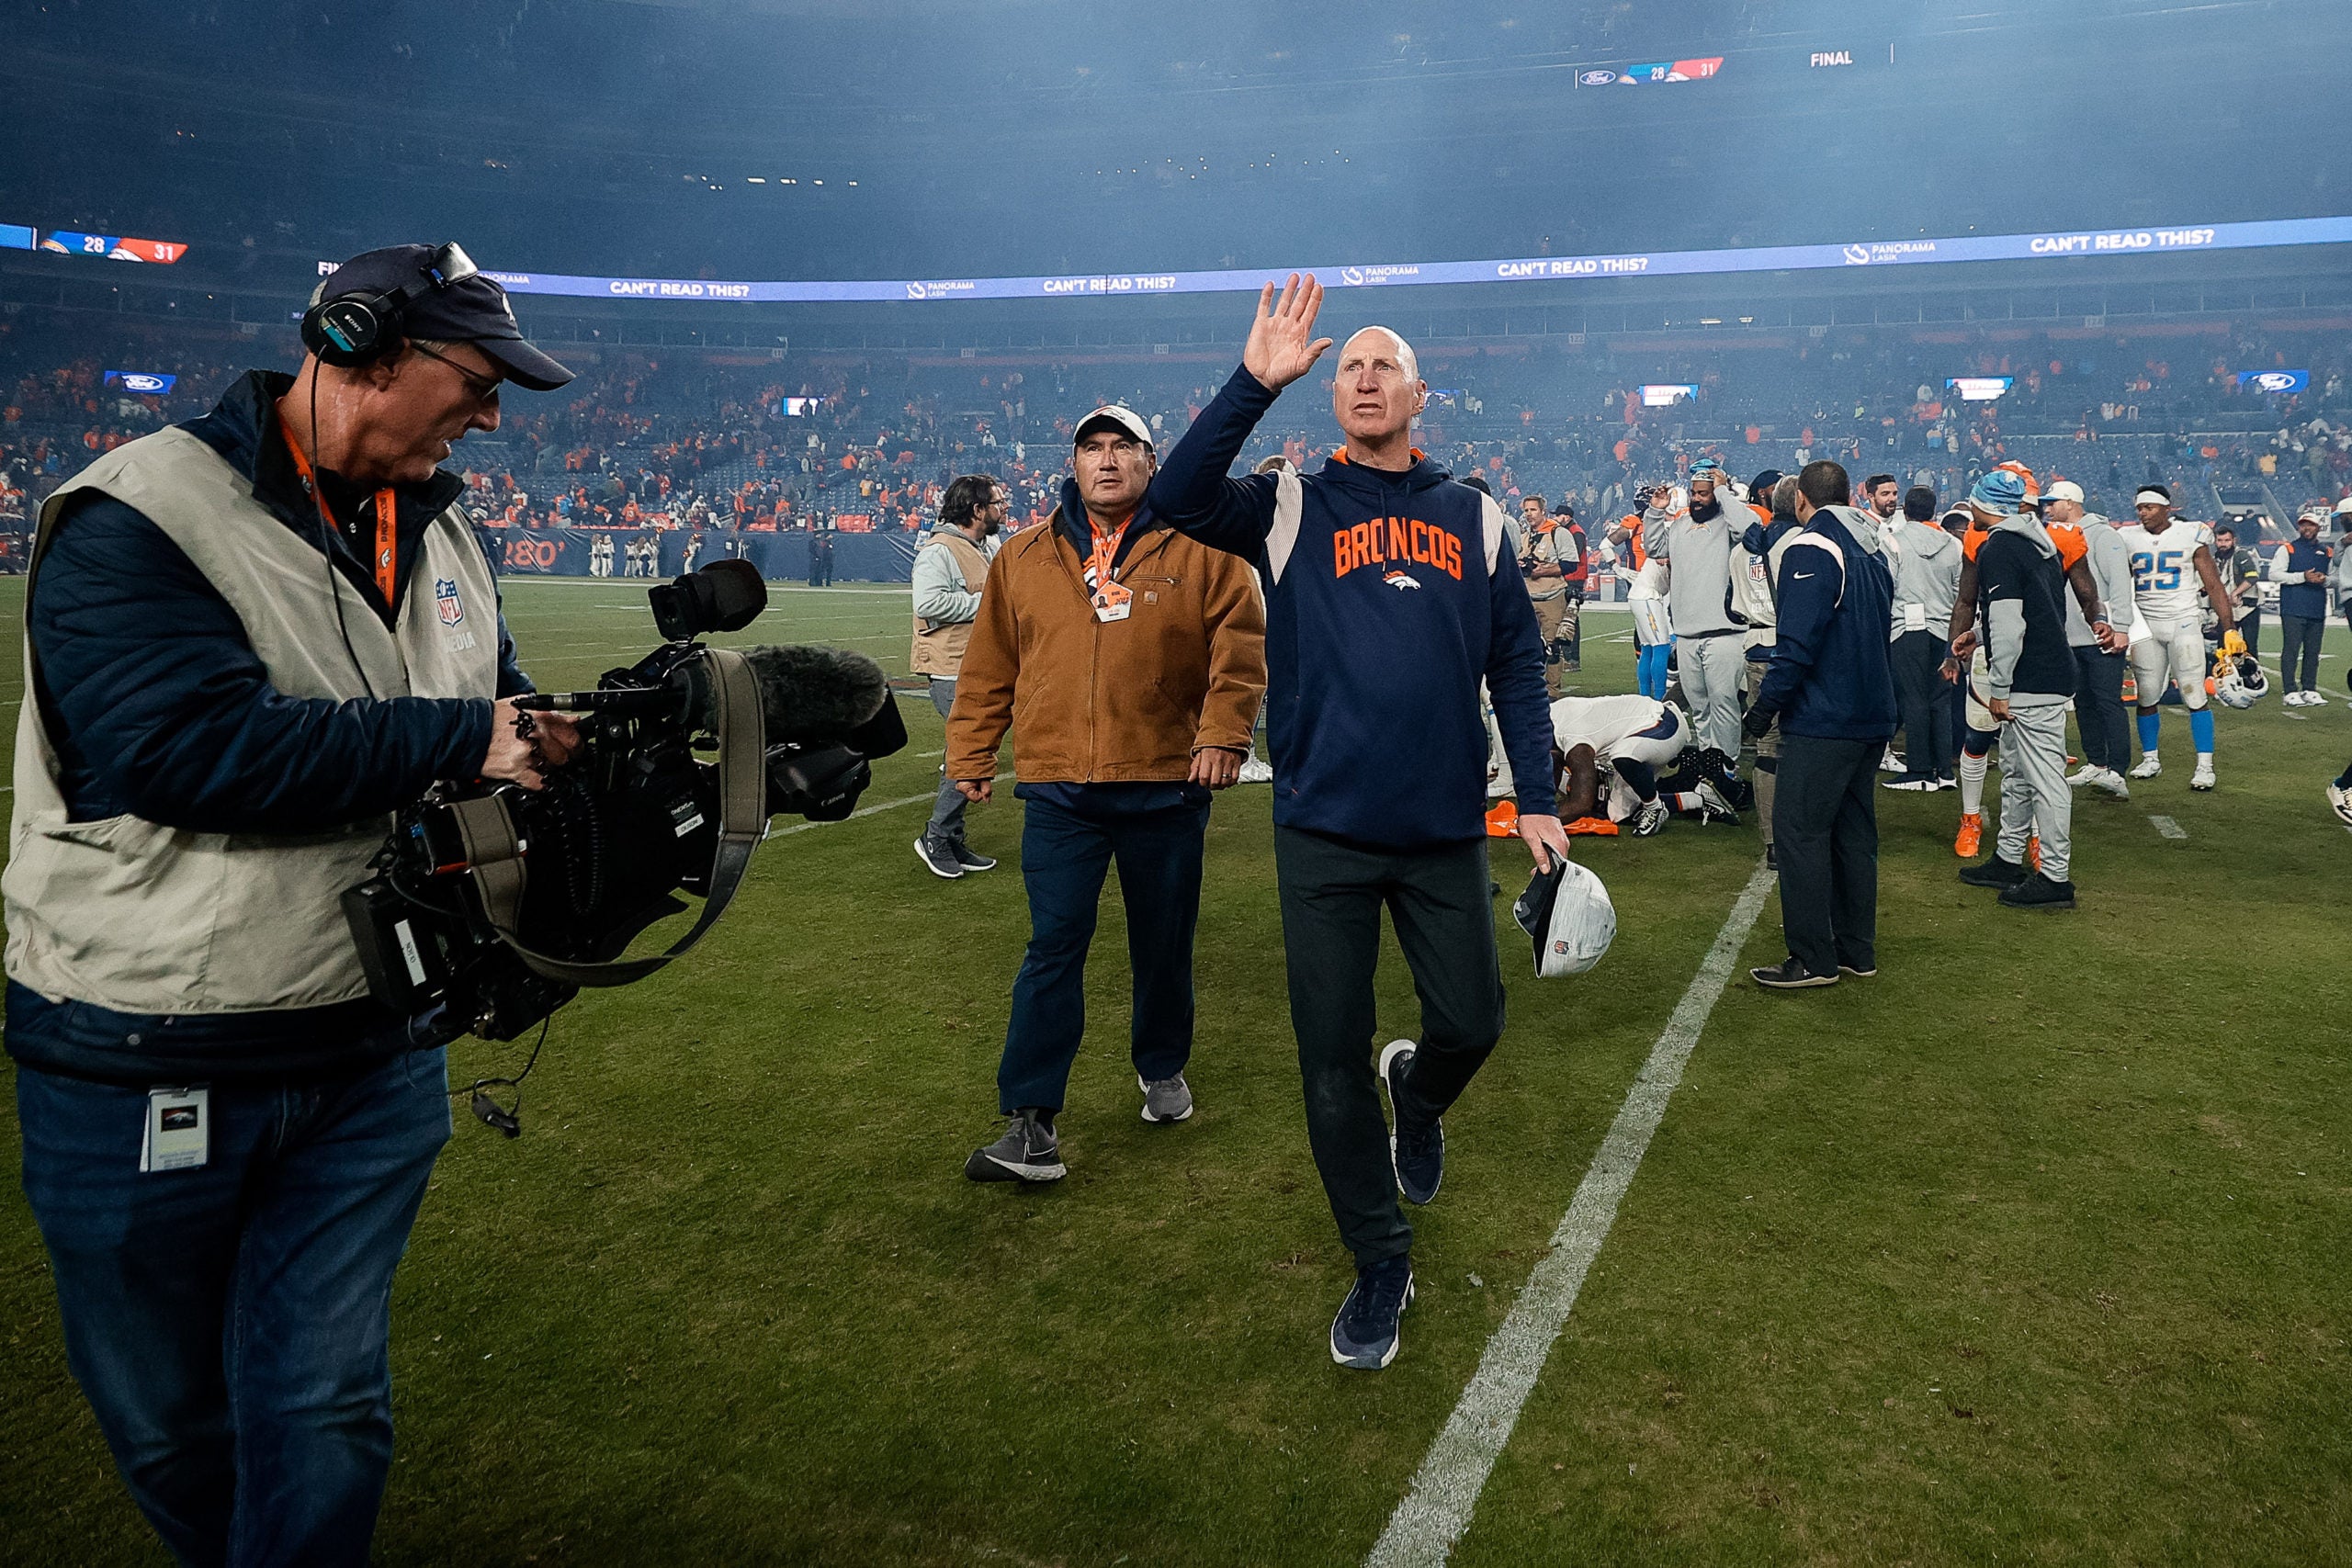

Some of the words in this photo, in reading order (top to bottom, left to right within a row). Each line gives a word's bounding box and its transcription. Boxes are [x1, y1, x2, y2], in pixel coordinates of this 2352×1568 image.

[1810, 51, 1853, 67] FINAL
[1651, 67, 1665, 80] 28
[1701, 62, 1714, 76] 31
[84, 236, 105, 253] 28
[154, 244, 174, 261] 31
[1871, 242, 1936, 254] PANORAMA
[2030, 236, 2090, 254] CAN'T
[2095, 232, 2152, 249] READ
[2156, 228, 2215, 246] THIS?
[1871, 253, 1898, 262] LASIK
[1365, 265, 1419, 276] PANORAMA
[1497, 262, 1547, 276] CAN'T
[1551, 260, 1598, 275] READ
[1601, 257, 1649, 273] THIS?
[927, 281, 975, 291] PANORAMA
[1043, 279, 1087, 293] CAN'T
[1090, 278, 1133, 291] READ
[1135, 276, 1176, 289] THIS?
[1365, 275, 1387, 284] LASIK
[609, 281, 657, 295] CAN'T
[660, 284, 704, 297] READ
[707, 285, 750, 298] THIS?
[927, 290, 947, 299] LASIK
[379, 497, 389, 542] BRONCOS
[1333, 516, 1463, 581] BRONCOS
[2132, 551, 2184, 592] 25
[437, 598, 460, 622] NFL
